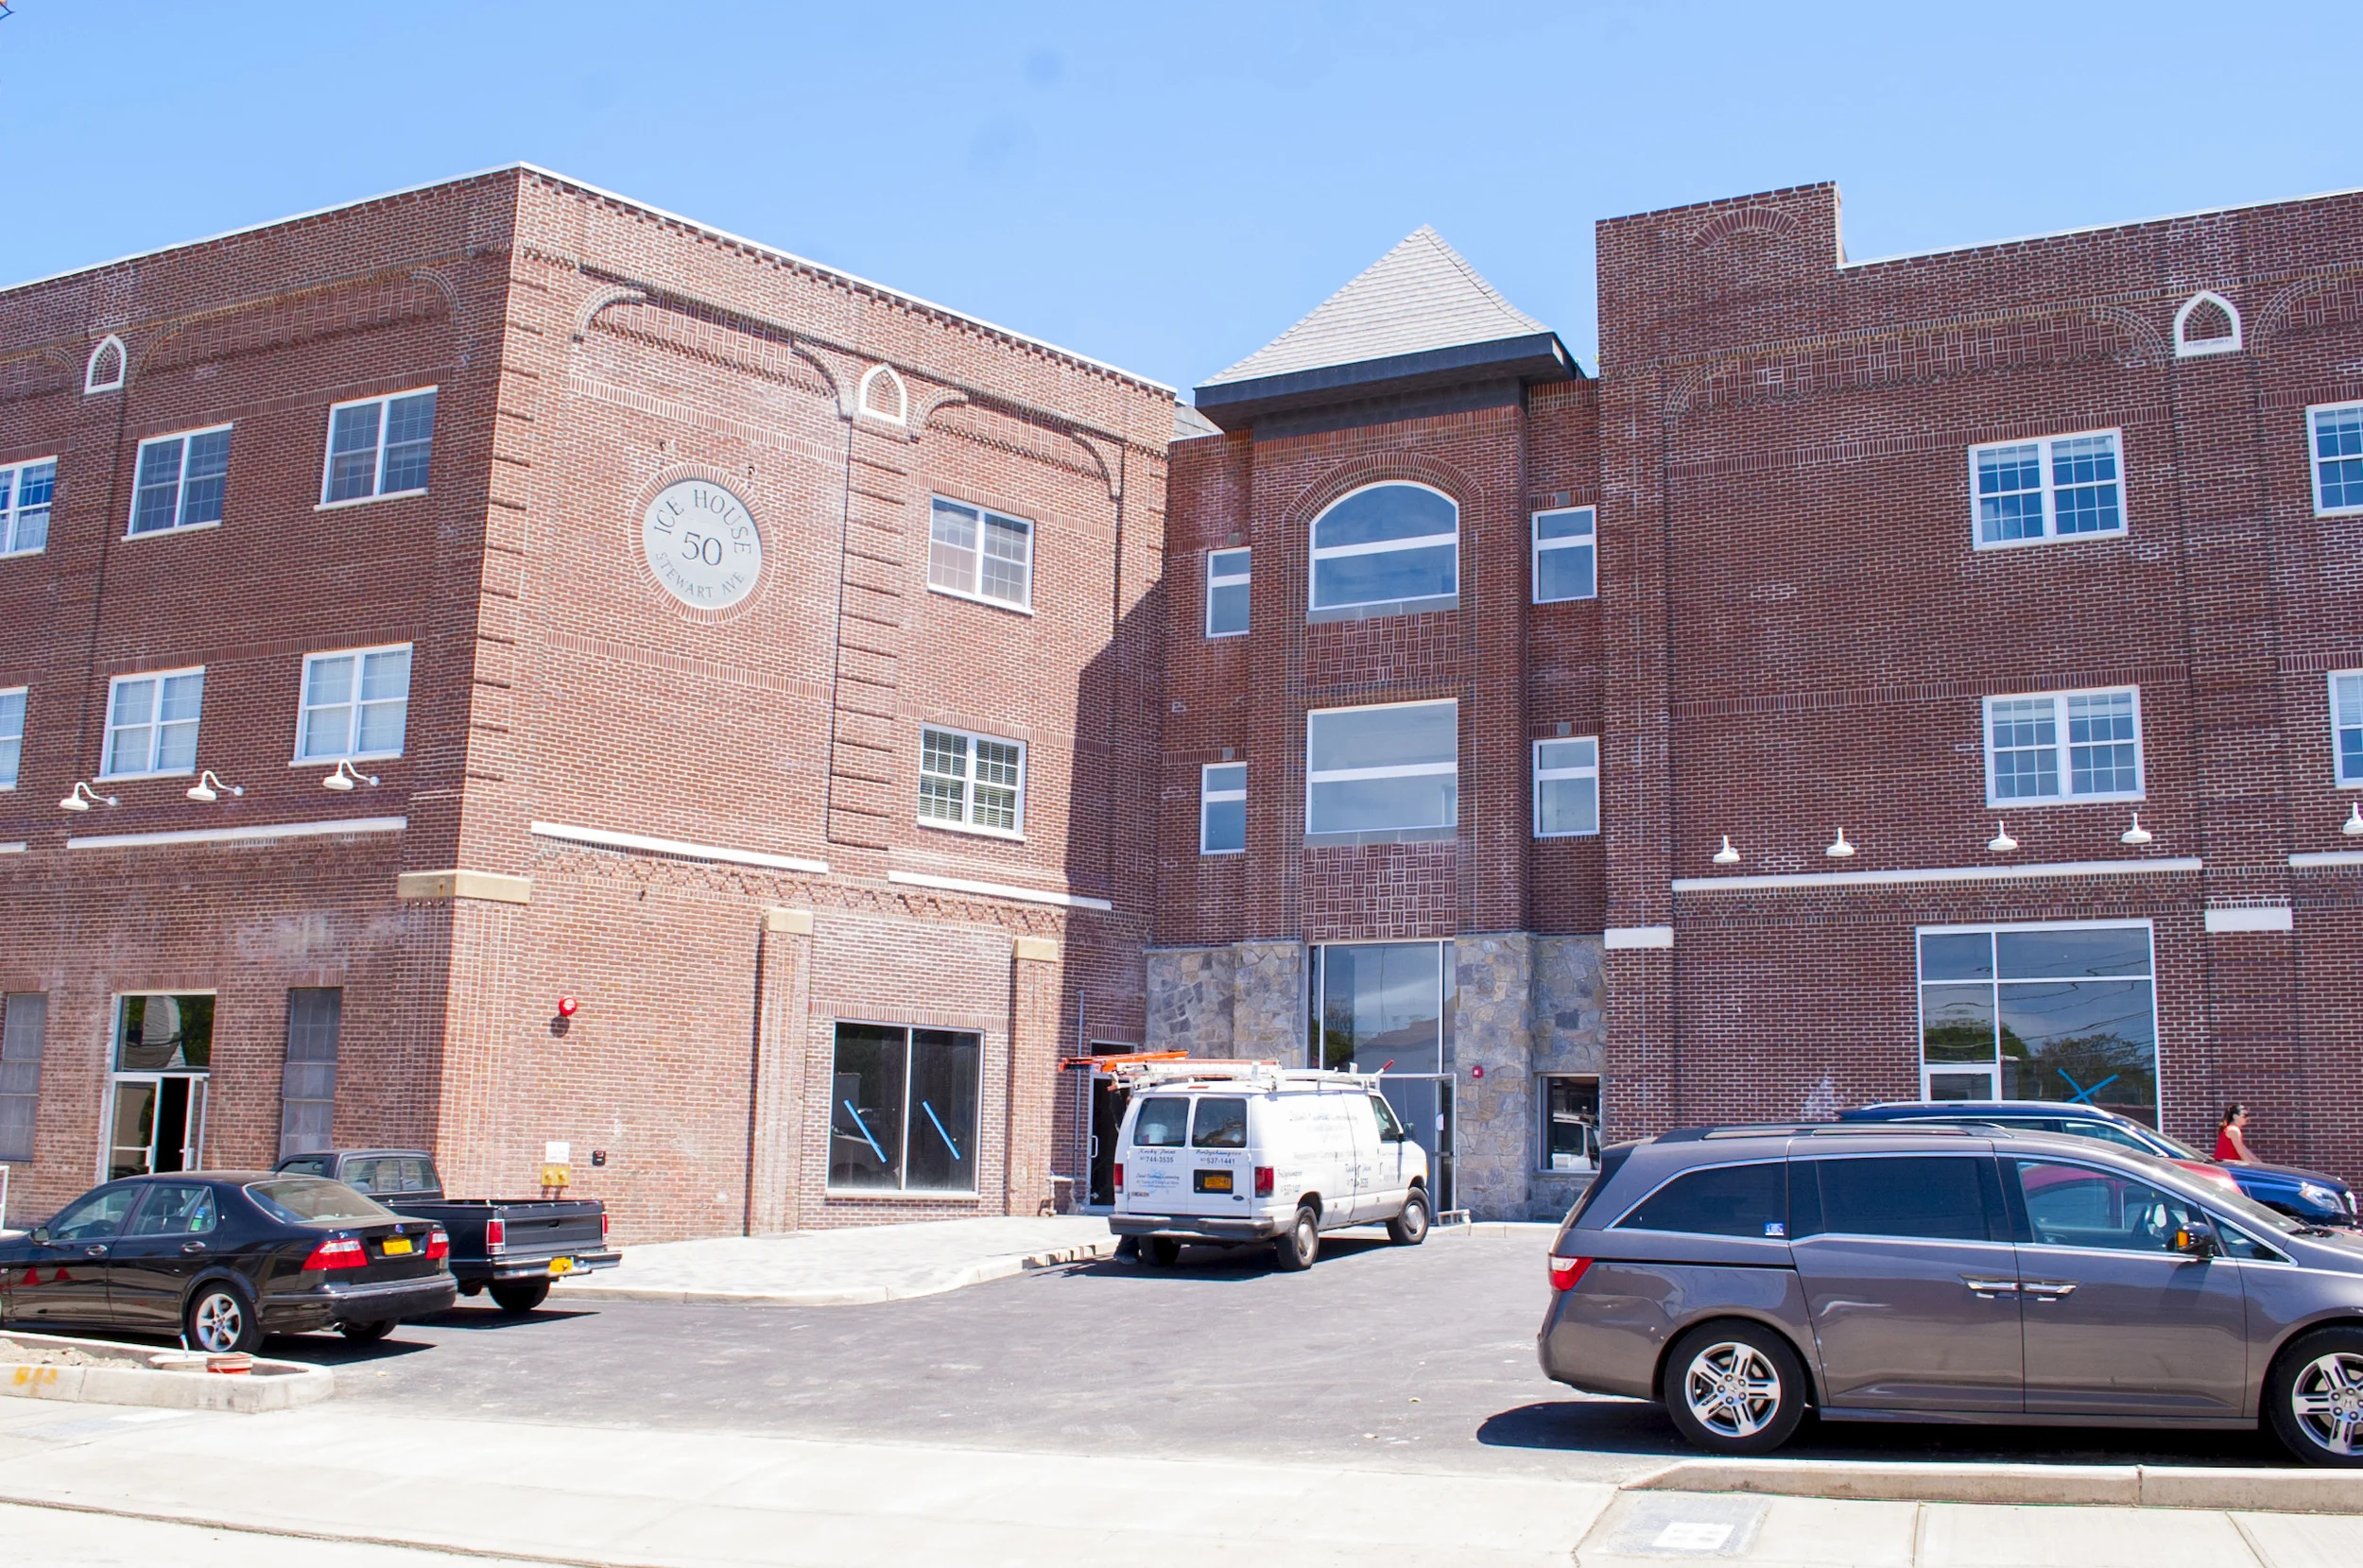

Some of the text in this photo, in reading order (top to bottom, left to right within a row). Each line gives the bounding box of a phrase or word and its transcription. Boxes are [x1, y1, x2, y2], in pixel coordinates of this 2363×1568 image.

[654, 489, 751, 554] ICE HOUSE
[681, 531, 722, 565] 50
[656, 552, 745, 598] STEWART AVE
